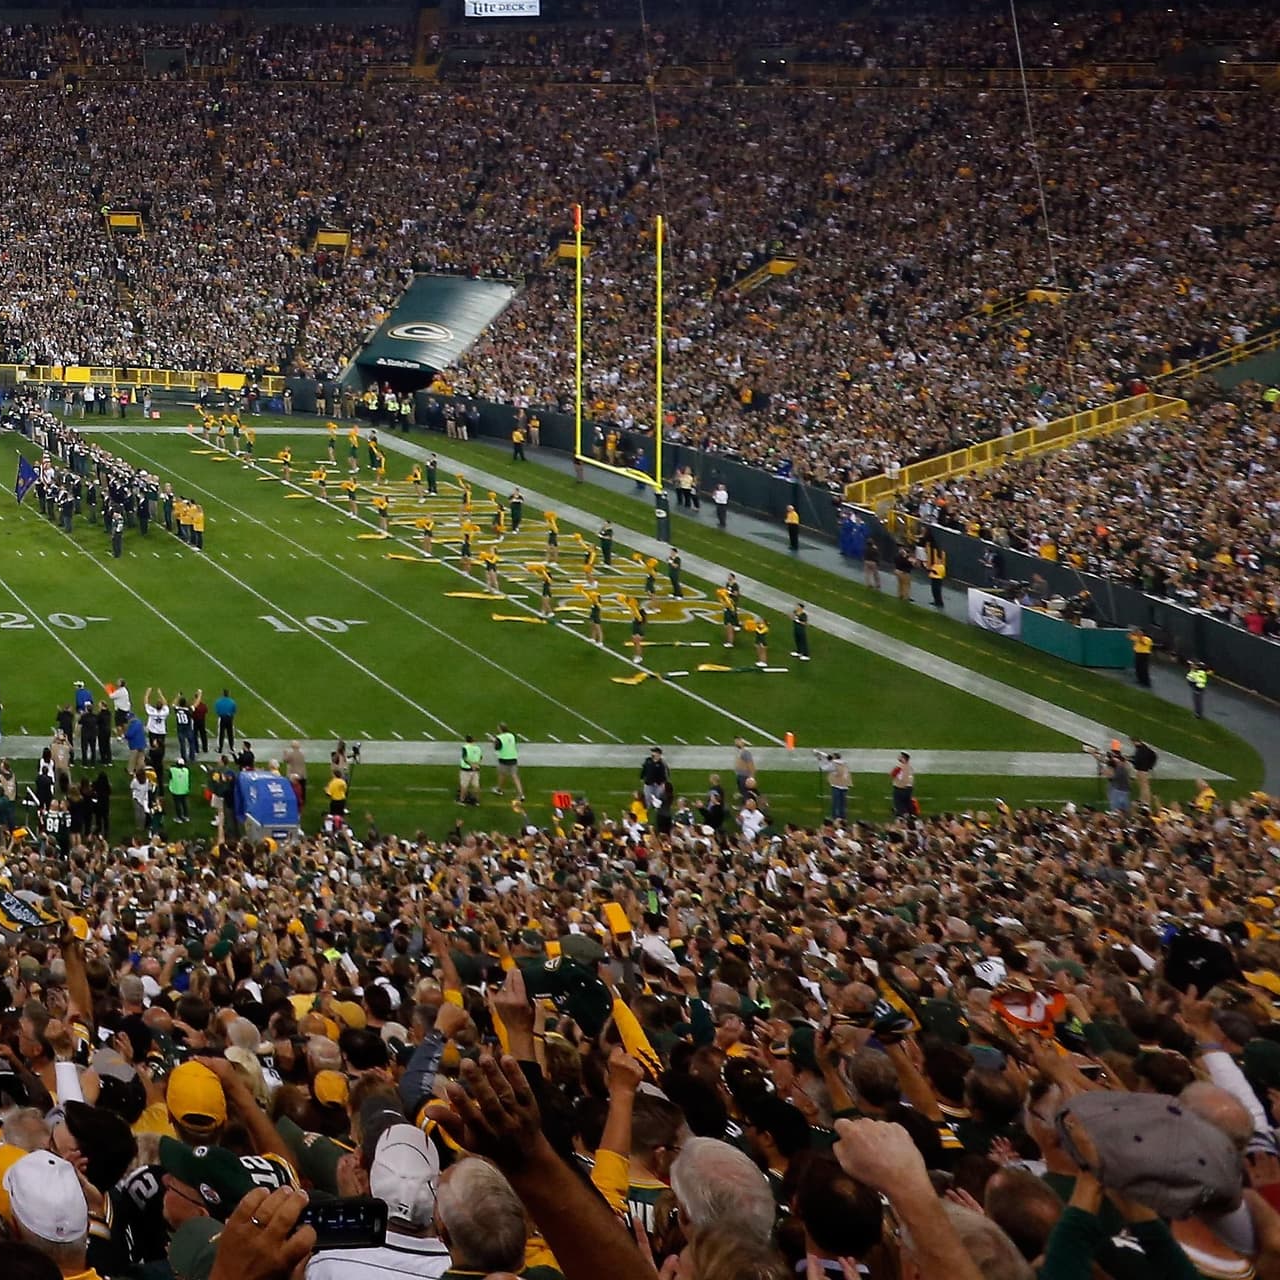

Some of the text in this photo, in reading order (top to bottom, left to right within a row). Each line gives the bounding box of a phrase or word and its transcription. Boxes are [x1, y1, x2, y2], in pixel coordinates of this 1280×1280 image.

[472, 1, 525, 16] Lite DECK
[257, 614, 351, 634] 10
[558, 794, 571, 809] 10
